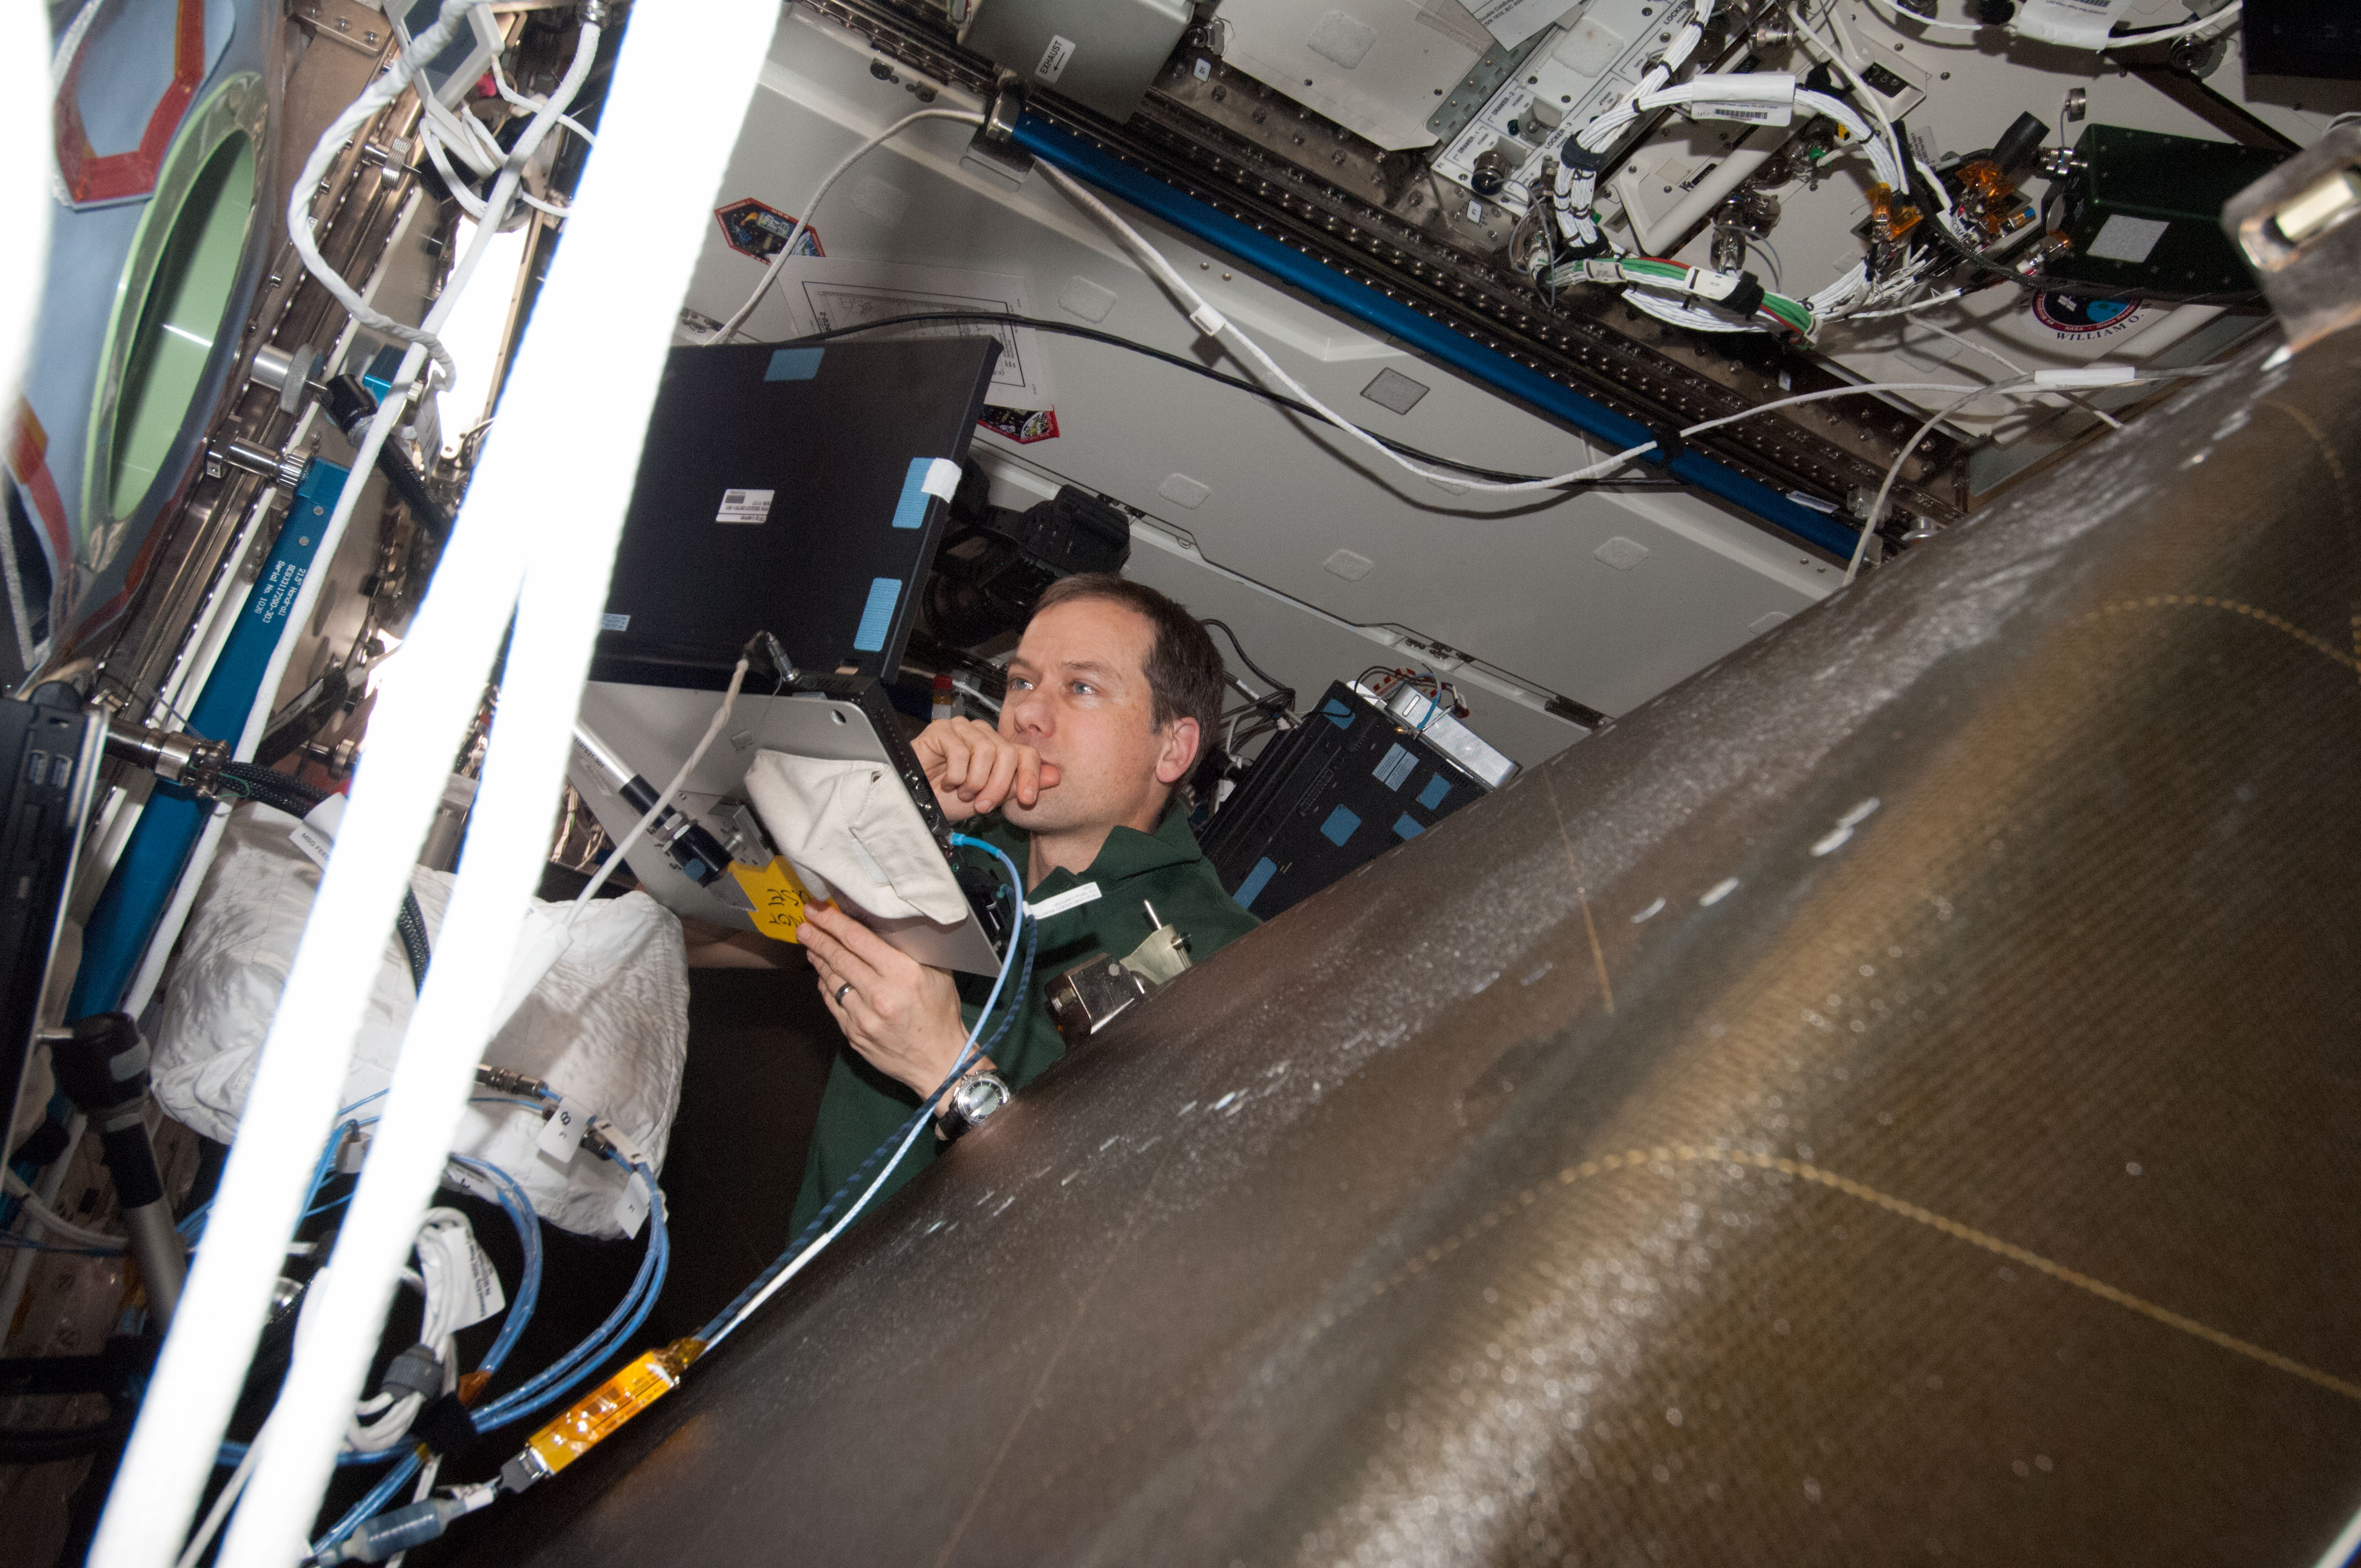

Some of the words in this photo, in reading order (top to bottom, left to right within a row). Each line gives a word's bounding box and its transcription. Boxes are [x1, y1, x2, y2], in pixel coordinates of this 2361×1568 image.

[1663, 0, 1687, 25] LOCKER
[1039, 40, 1063, 75] EXHAUST
[1491, 96, 1510, 116] DRAWER
[1457, 135, 1475, 154] DRAWER
[1544, 128, 1566, 149] LOCKER
[2057, 323, 2127, 341] WILLIAM
[269, 559, 285, 582] Serial
[263, 583, 274, 595] No.
[278, 586, 297, 616] Handrail
[300, 832, 315, 847] MSG
[769, 913, 803, 927] NOT
